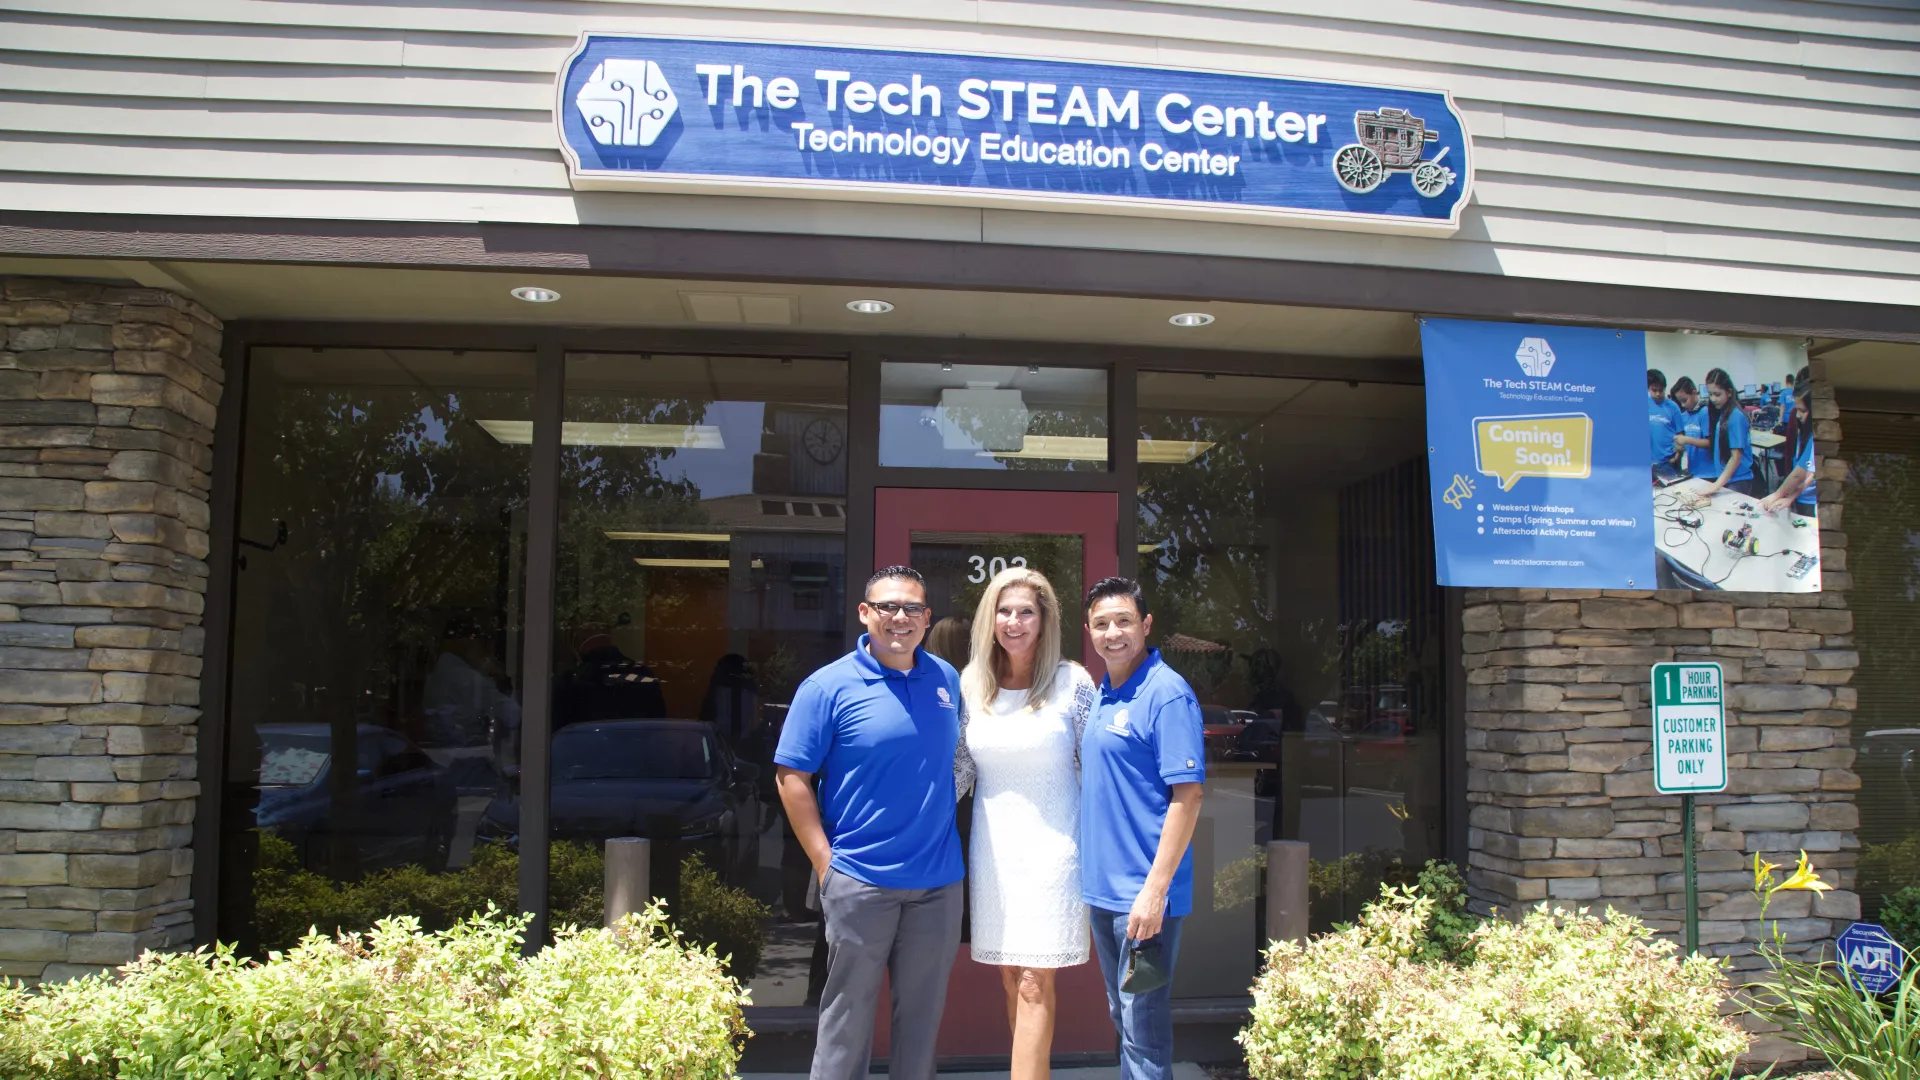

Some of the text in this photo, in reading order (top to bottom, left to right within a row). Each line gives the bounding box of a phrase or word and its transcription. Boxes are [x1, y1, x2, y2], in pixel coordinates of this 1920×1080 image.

[696, 63, 1326, 144] The Tech STEAM Center
[790, 121, 1240, 176] Technology Education Center
[1483, 378, 1596, 393] The Tech STEAM Center
[1499, 391, 1584, 403] Technology Education Center
[1489, 424, 1564, 448] Coming
[1515, 447, 1572, 467] Soon!
[1492, 503, 1575, 515] Weekend Workshops
[1492, 514, 1637, 528] Camps (Spring, Summer and Winter)
[1492, 528, 1597, 538] Afterschool Activity Center
[1492, 558, 1585, 567] www.techsteamcenter.com
[1664, 672, 1671, 699] 1
[1687, 671, 1711, 685] HOUR
[1682, 686, 1718, 699] PARKING
[1663, 718, 1716, 734] CUSTOMER
[1668, 738, 1713, 754] PARKING
[1677, 759, 1705, 774] ONLY
[1848, 945, 1891, 971] ADT
